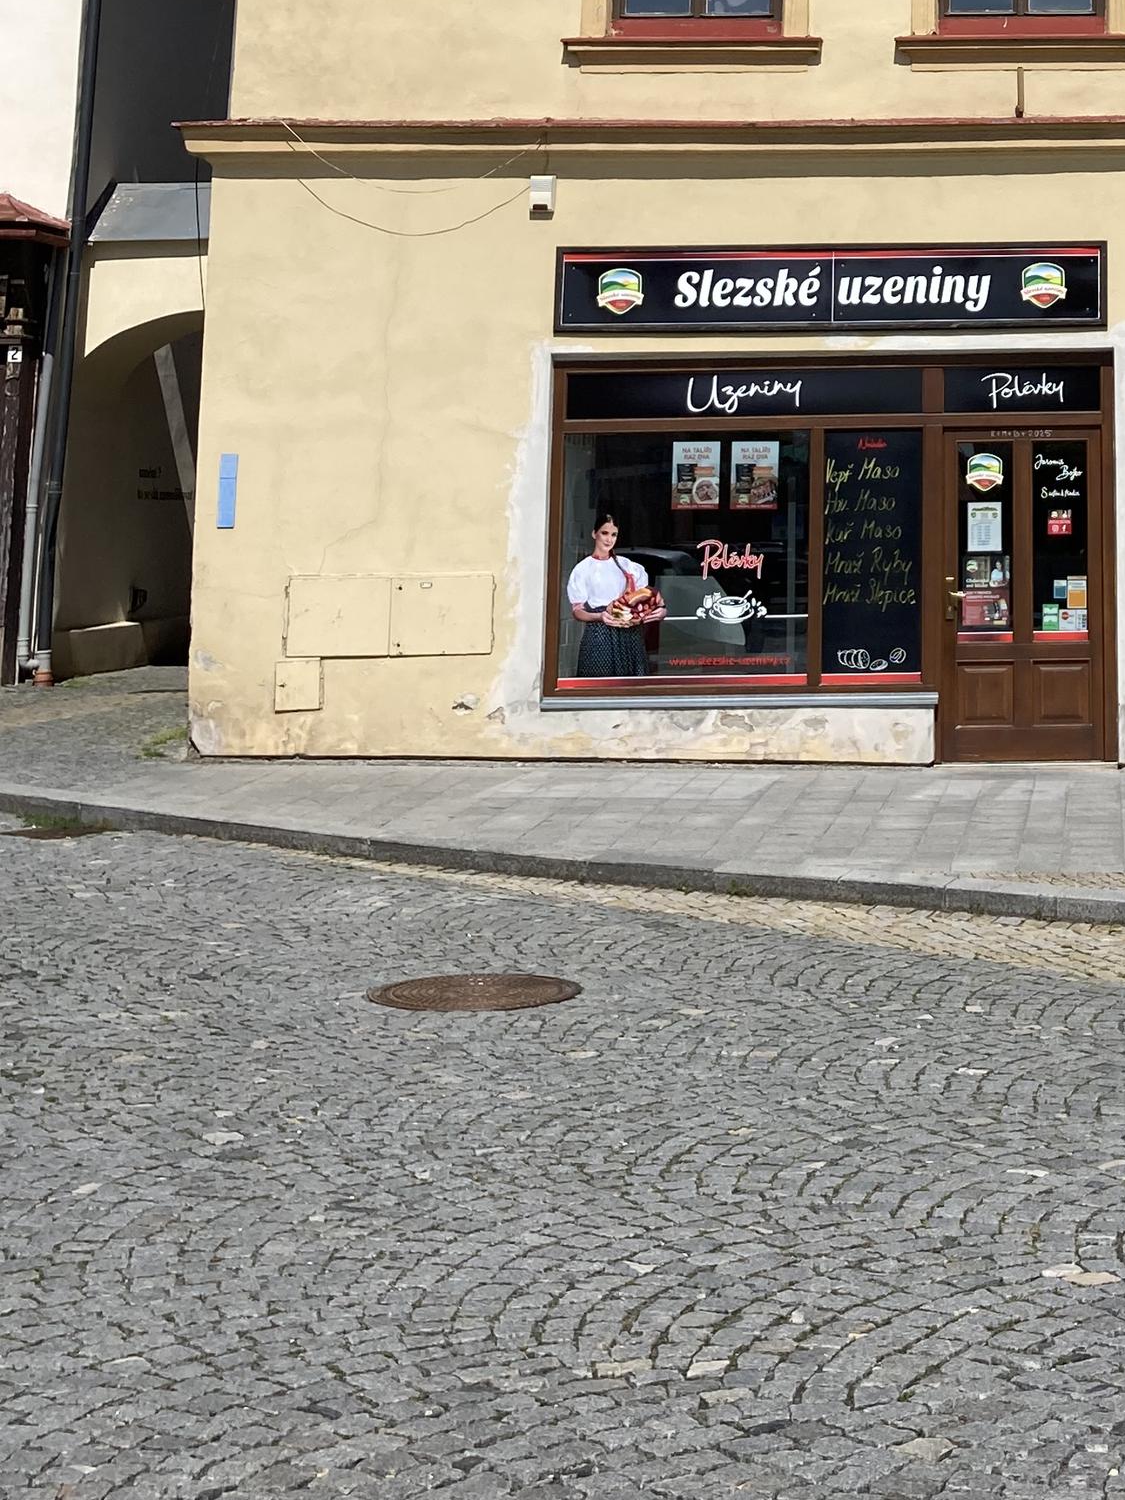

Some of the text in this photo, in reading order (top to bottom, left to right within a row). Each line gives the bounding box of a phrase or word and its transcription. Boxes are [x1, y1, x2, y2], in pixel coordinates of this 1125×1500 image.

[674, 265, 991, 312] Slezské uzeniny
[11, 347, 19, 360] 2
[686, 375, 802, 414] Uzeniny
[858, 457, 900, 480] Maso
[854, 489, 896, 511] Maso
[860, 520, 902, 539] Maso
